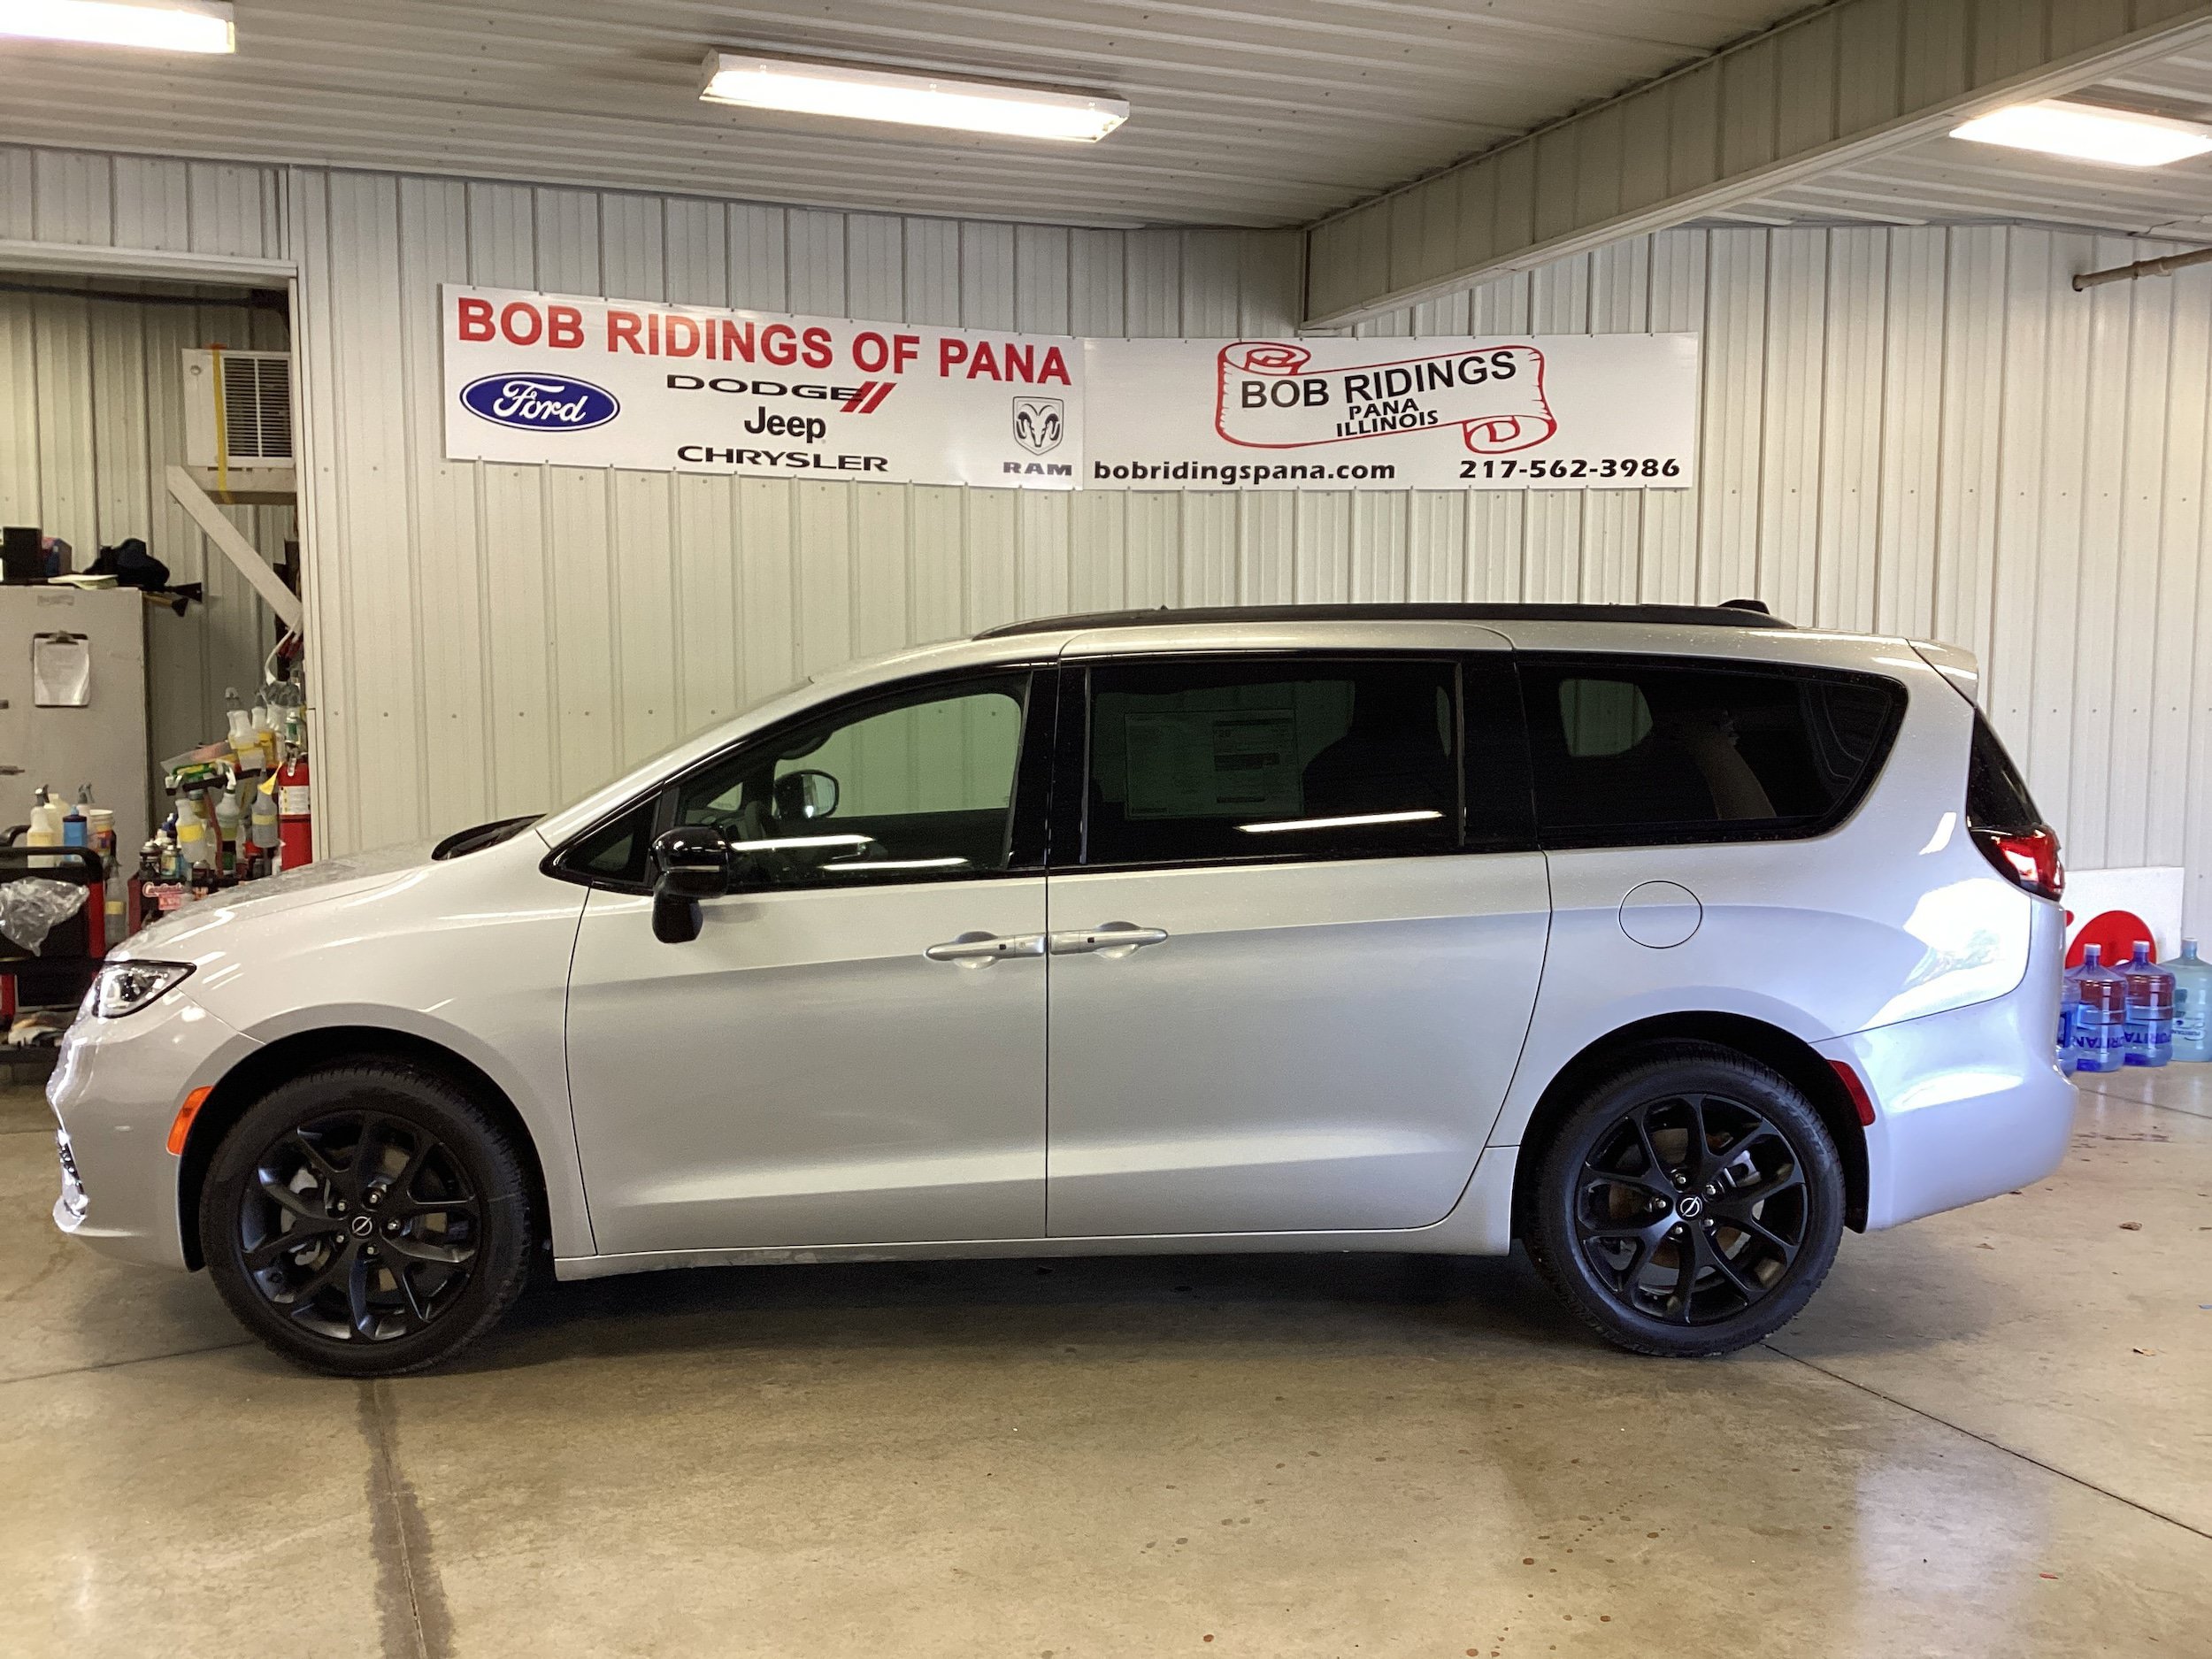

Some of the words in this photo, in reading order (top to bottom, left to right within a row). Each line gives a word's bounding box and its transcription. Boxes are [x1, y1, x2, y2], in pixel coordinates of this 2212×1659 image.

[457, 296, 585, 349] BOB
[606, 310, 833, 370] RIDINGS
[851, 331, 921, 375] OF
[939, 337, 1071, 386] PANA
[666, 374, 864, 403] DODGE
[1241, 379, 1330, 409] BOB
[1344, 350, 1517, 404] RIDINGS
[493, 380, 588, 422] Ford
[1348, 397, 1420, 420] PANA
[743, 406, 826, 444] Jeep
[1336, 410, 1440, 437] ILLINOIS
[677, 445, 889, 472] CHRYSLER
[1003, 462, 1072, 476] RAM
[1459, 458, 1680, 479] 217-562-3986
[1094, 460, 1395, 486] bobridingspana.com
